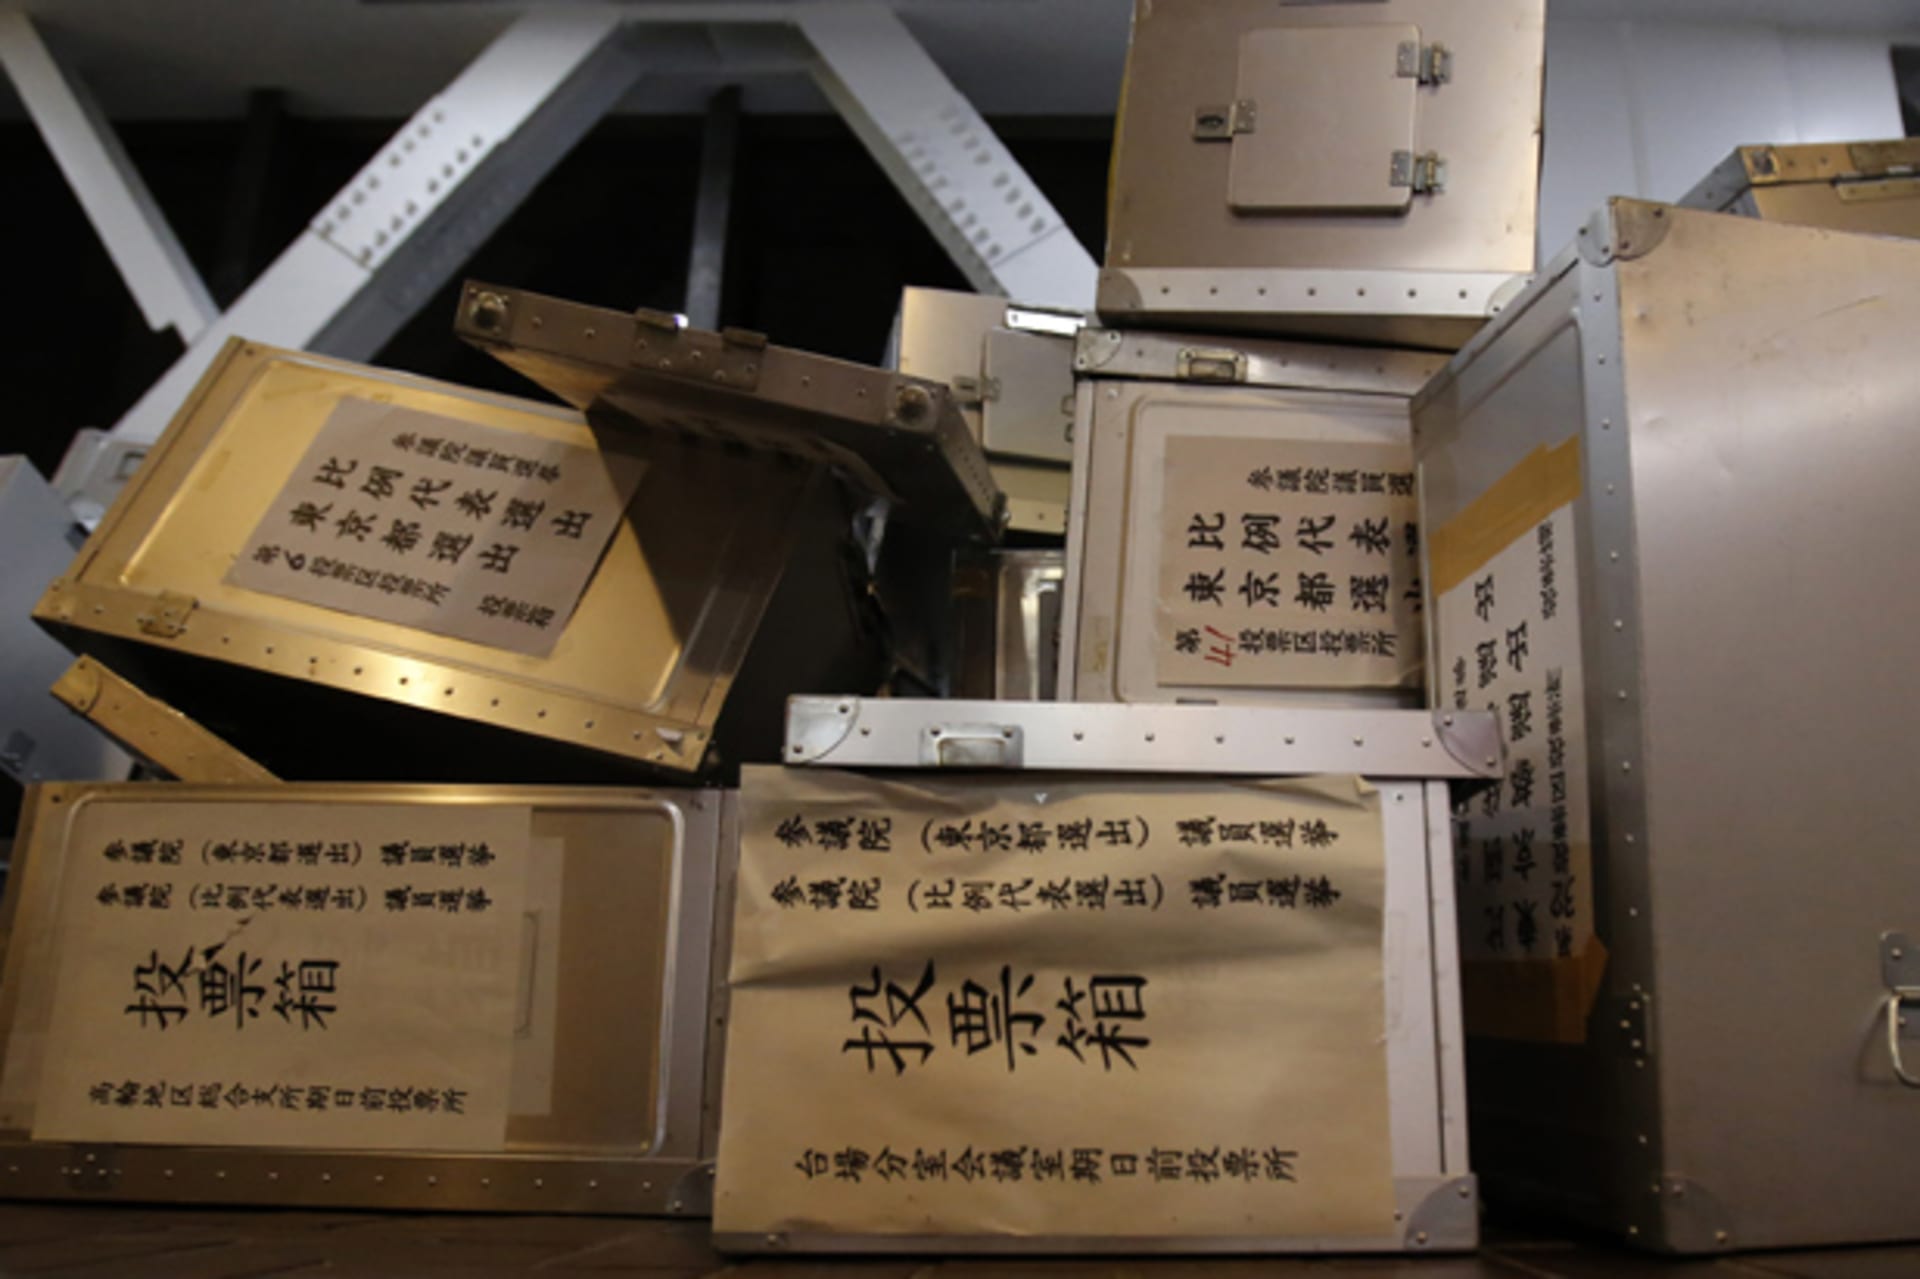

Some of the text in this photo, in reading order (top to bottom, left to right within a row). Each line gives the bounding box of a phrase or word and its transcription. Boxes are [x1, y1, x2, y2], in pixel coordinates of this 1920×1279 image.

[289, 502, 520, 574] 東京都選出
[314, 457, 592, 540] 比例代表選出
[252, 544, 556, 629] 第6投票区投票所 投票箱
[1175, 625, 1398, 666] 第41投票区投票所
[1506, 620, 1536, 953] 東京都選出
[125, 945, 340, 1029] 投票箱
[843, 959, 1151, 1075] 投票箱
[90, 1082, 468, 1114] 高輪地区総合支所期日前投票所
[796, 1146, 1297, 1183] 台場分室会議室期日前投票所
